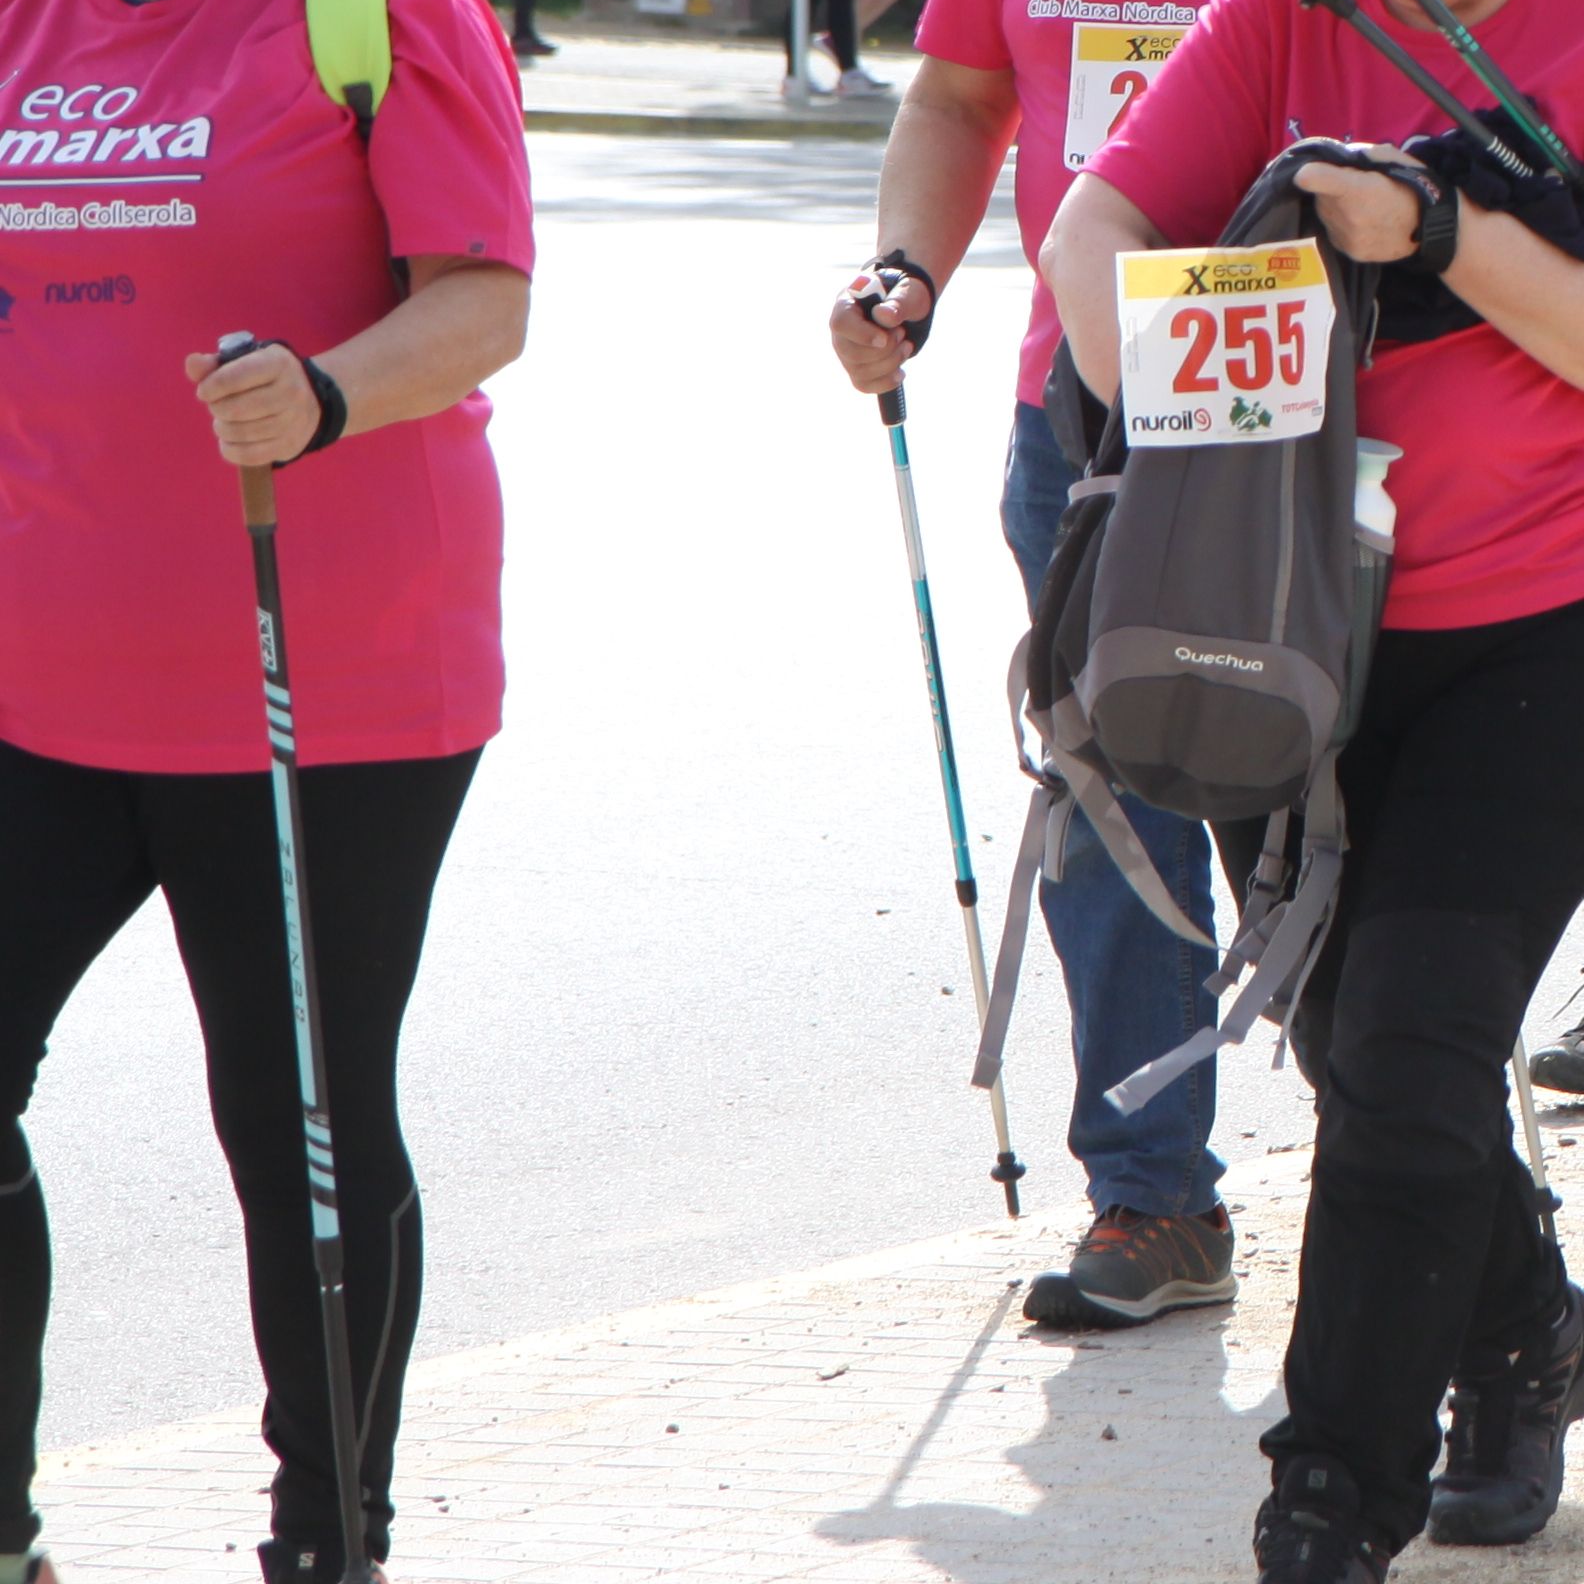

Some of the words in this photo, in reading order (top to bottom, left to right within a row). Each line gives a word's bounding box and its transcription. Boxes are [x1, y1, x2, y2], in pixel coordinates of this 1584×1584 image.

[1063, 0, 1118, 20] Marxa
[1122, 3, 1196, 22] Nòrdica
[21, 85, 138, 121] eco
[0, 116, 211, 164] marxa
[82, 200, 196, 228] Collserola
[46, 276, 115, 304] nuroil
[1183, 265, 1211, 296] X
[1213, 264, 1253, 278] eco
[1213, 276, 1276, 293] marxa
[1170, 299, 1307, 394] 255
[1132, 410, 1193, 432] nuroil
[1174, 647, 1263, 672] Quechua
